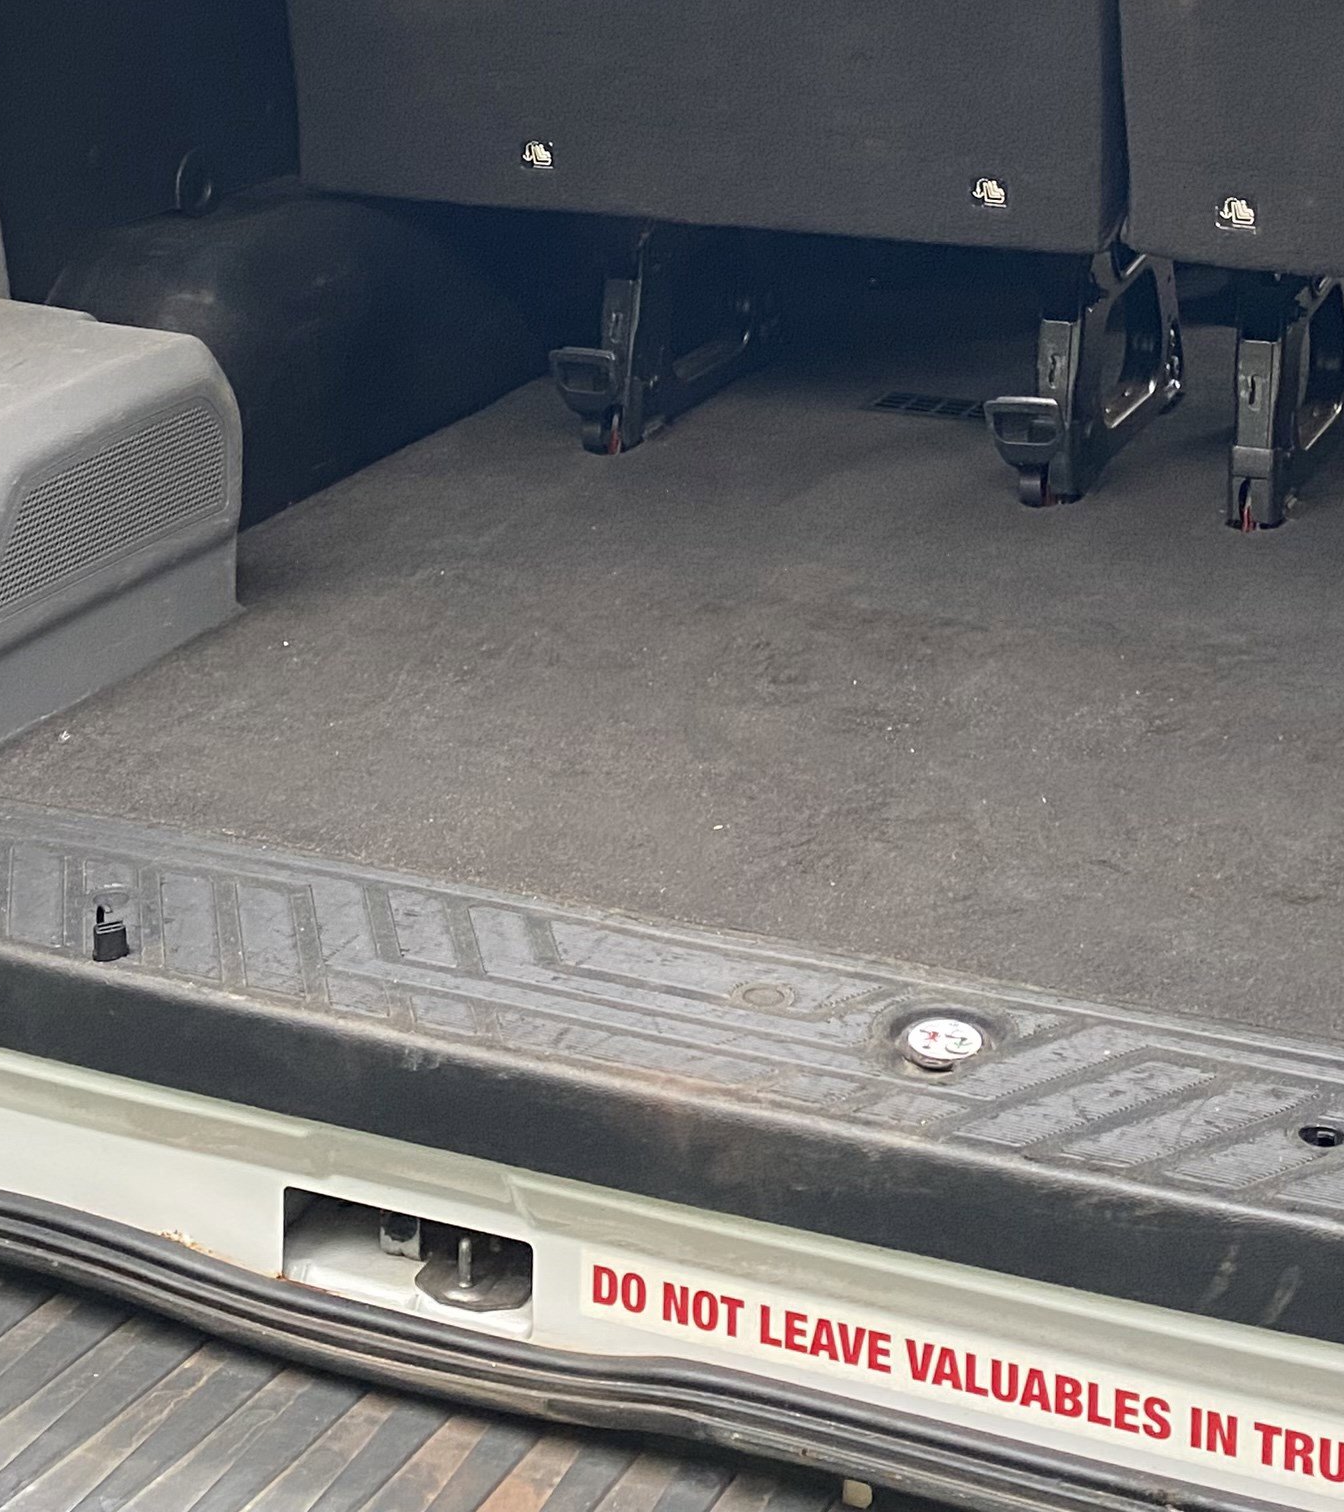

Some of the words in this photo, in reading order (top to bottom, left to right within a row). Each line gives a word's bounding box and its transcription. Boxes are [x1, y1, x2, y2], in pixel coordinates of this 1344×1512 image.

[592, 1264, 647, 1314] DO
[662, 1281, 745, 1337] NOT
[759, 1304, 892, 1374] LEAVE
[905, 1338, 1172, 1440] VALUABLES
[1189, 1406, 1238, 1458] IN
